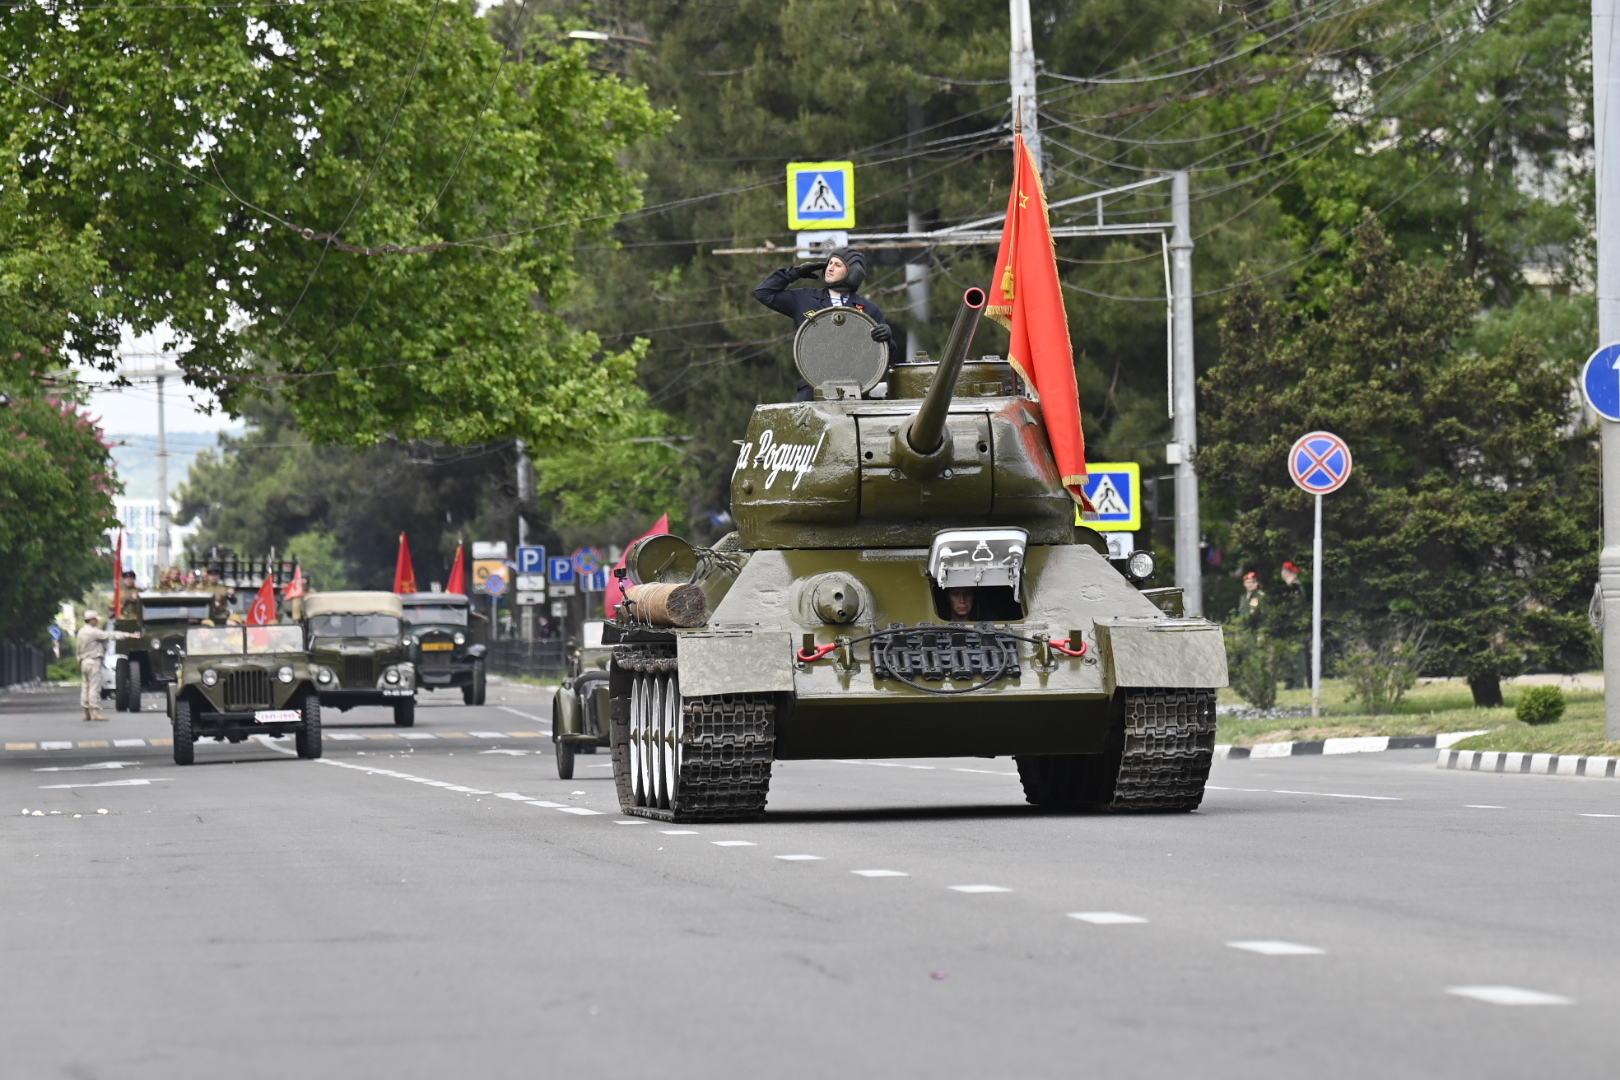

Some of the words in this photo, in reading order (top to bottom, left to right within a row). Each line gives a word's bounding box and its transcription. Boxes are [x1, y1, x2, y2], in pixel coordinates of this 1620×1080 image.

[753, 429, 826, 490] Родину!
[523, 549, 539, 573] P
[555, 560, 569, 581] P
